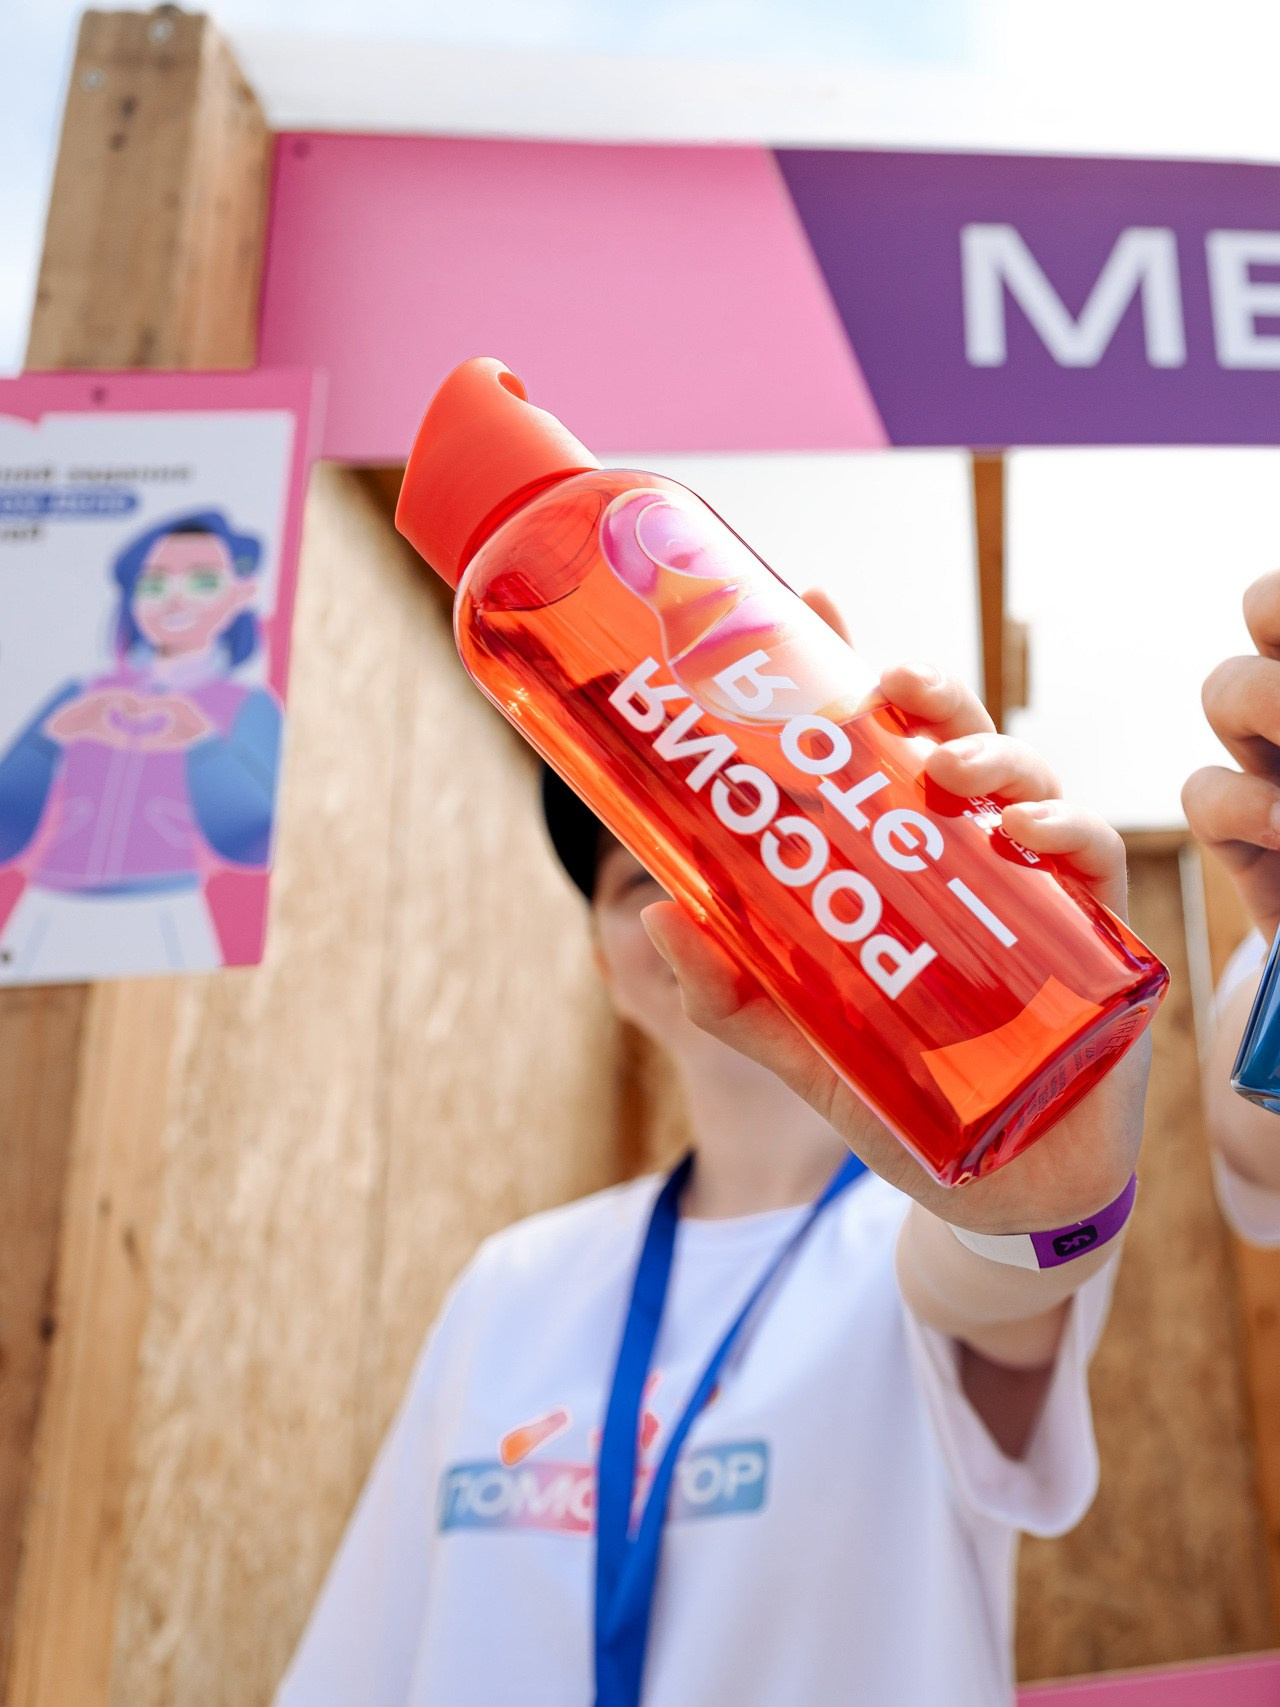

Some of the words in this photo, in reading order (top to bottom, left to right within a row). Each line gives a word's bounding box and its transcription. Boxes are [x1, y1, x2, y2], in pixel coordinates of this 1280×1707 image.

[714, 649, 799, 713] Я
[609, 656, 938, 1000] РОССИЯ
[780, 714, 945, 872] ЭТО
